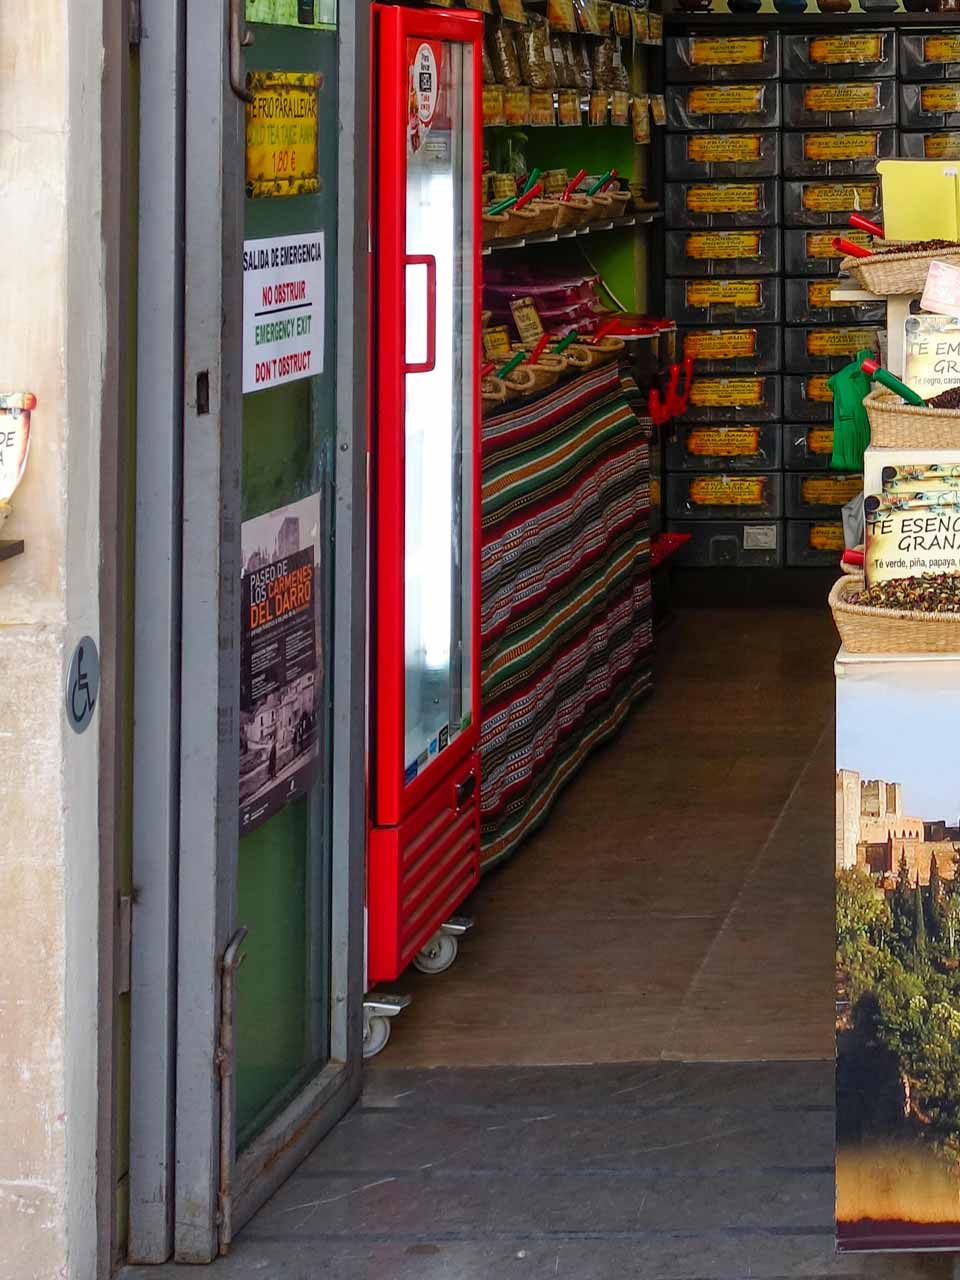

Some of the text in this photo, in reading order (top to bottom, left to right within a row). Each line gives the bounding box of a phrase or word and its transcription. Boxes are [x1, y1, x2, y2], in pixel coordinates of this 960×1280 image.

[242, 242, 322, 272] SALIDA DE EMERGENCIA
[262, 280, 306, 307] NO OBSTRUIR
[255, 315, 312, 346] EMERGENCY EXIT
[278, 351, 312, 377] OBSTRUCT
[870, 513, 894, 536] TÉ
[250, 559, 289, 587] PASEO DE
[874, 557, 957, 570] Té verde, piña, papaya,
[250, 563, 313, 607] LOS CARMENES
[250, 599, 274, 630] DEL
[275, 580, 312, 617] DARRO
